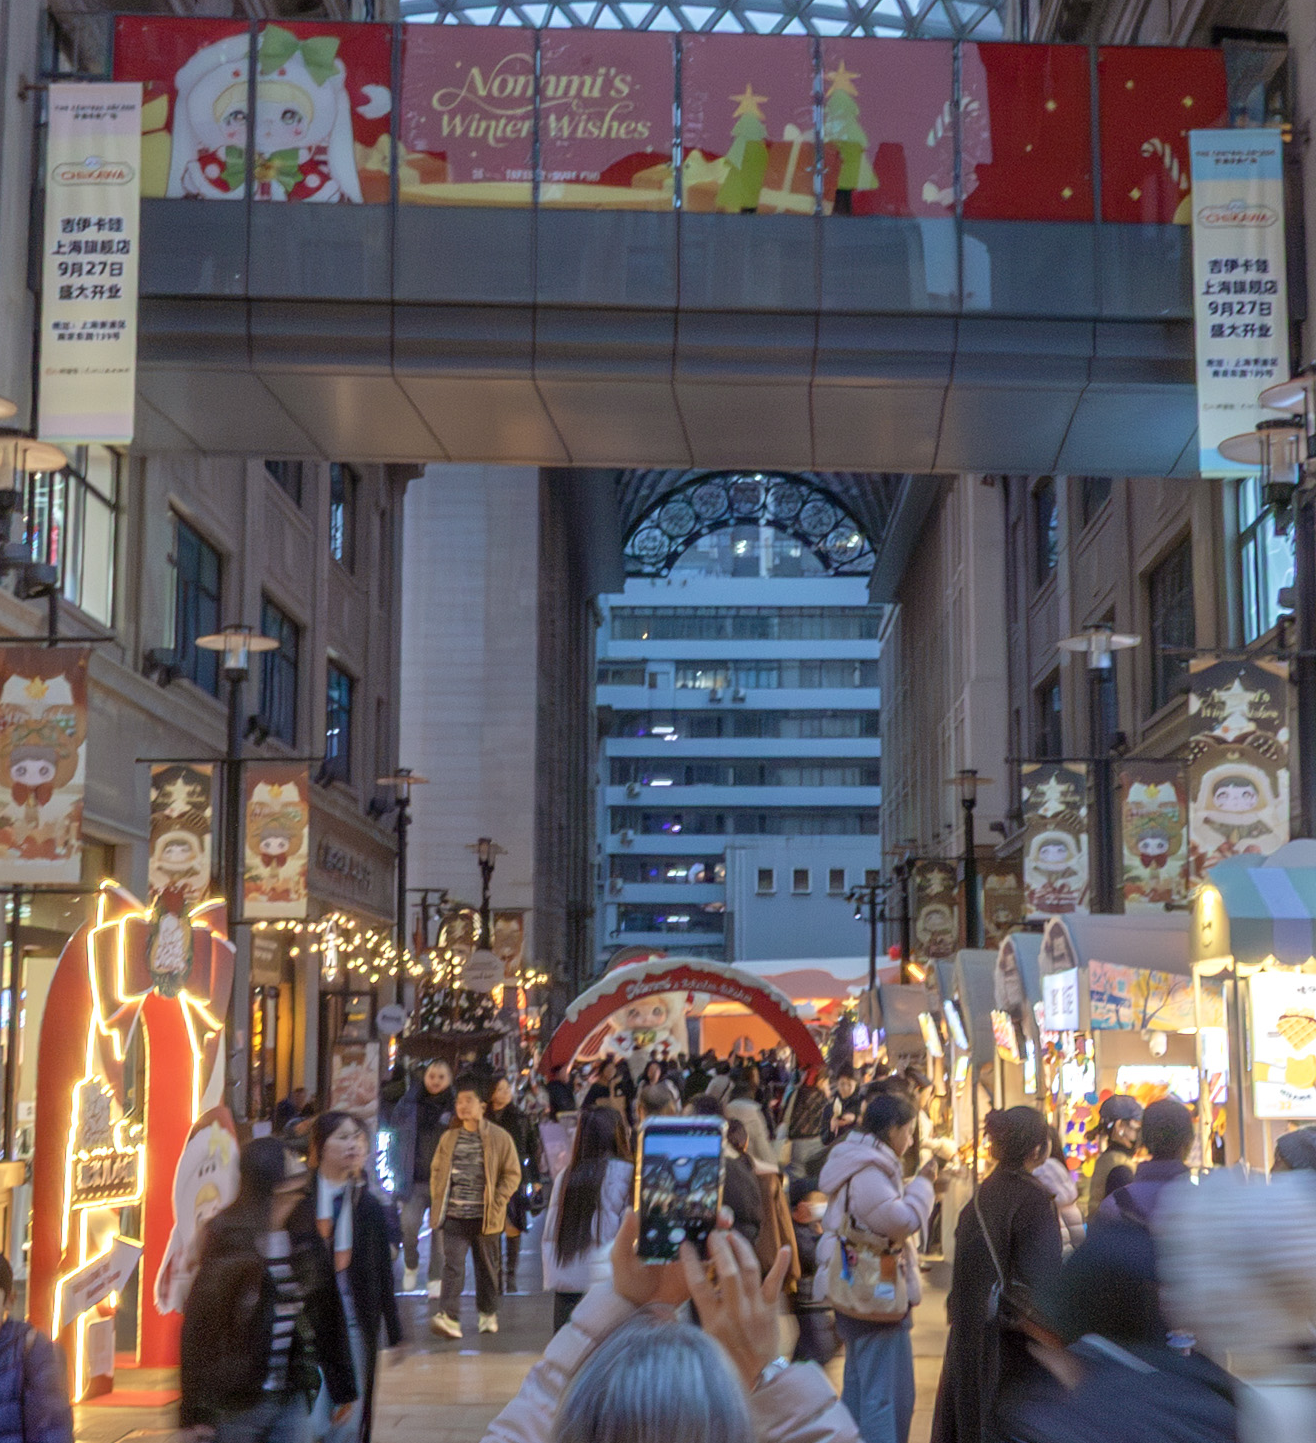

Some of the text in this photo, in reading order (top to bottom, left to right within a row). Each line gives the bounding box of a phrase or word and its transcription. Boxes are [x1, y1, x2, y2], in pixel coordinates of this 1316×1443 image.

[441, 101, 652, 148] Winter Wishes
[58, 261, 124, 278] 9月27日
[58, 284, 122, 301] 盛大开业
[1208, 301, 1272, 316] 9月27日
